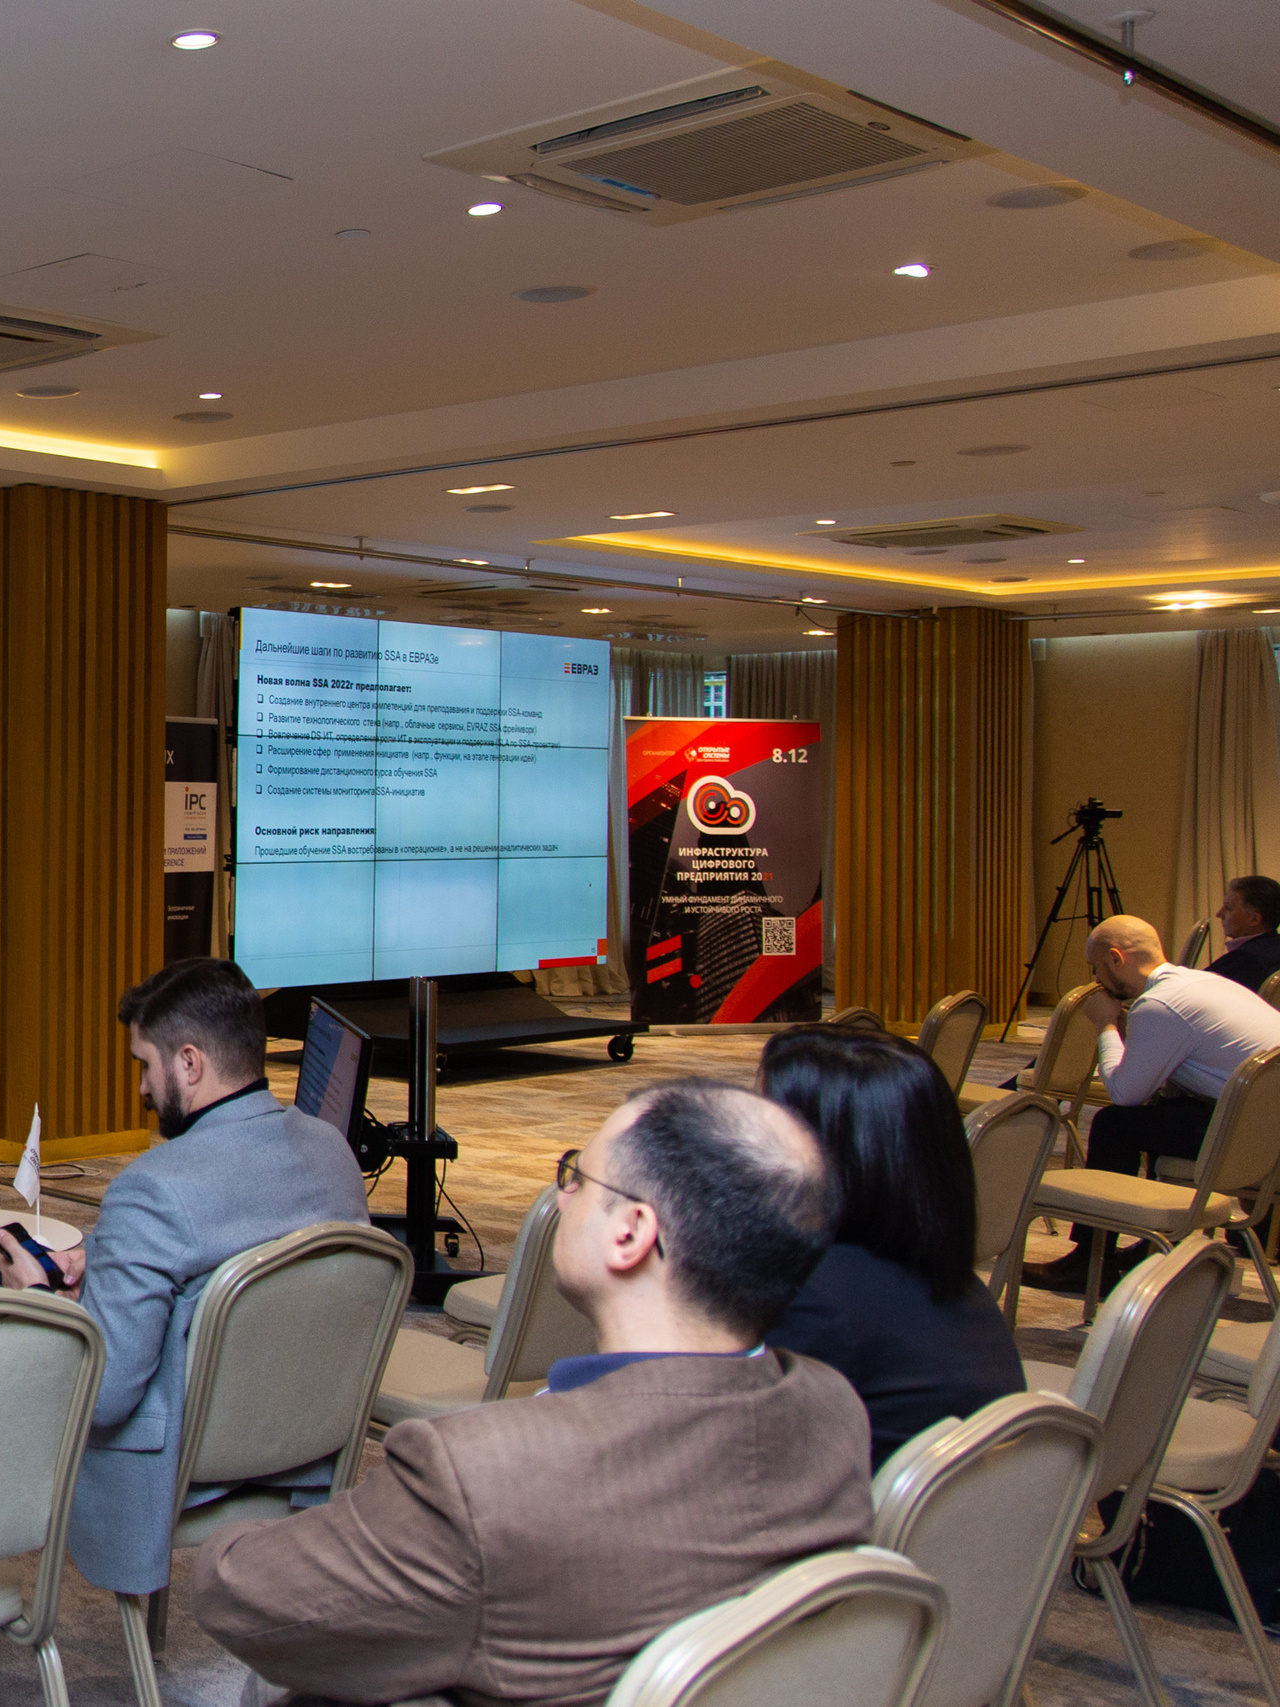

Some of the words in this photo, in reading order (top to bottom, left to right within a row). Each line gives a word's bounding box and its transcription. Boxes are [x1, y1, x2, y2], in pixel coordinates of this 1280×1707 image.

[255, 640, 310, 655] Дальнейшие
[311, 646, 331, 657] шаги
[333, 648, 343, 658] по
[345, 649, 383, 661] развитию
[384, 650, 401, 662] SSA
[402, 654, 407, 662] в
[409, 651, 439, 664] ЕВРАЗе
[571, 663, 599, 676] ЕВРАЗ
[257, 674, 283, 686] Новая
[285, 678, 311, 688] волна
[312, 678, 329, 689] SSA
[331, 679, 354, 690] 2022г
[355, 682, 412, 693] предполагает:
[268, 694, 304, 706] Создание
[305, 698, 346, 709] внутреннего
[347, 701, 371, 711] центра
[414, 704, 426, 715] для
[268, 712, 301, 724] Развитие
[302, 715, 361, 727] технологического
[467, 722, 488, 733] EVRAZ
[268, 745, 312, 757] Расширение
[313, 746, 331, 758] сфер
[772, 748, 808, 763] 8.12
[267, 764, 320, 777] Формирование
[320, 766, 373, 777] дистанционного
[393, 767, 423, 779] обучения
[423, 768, 438, 778] SSA
[267, 784, 302, 796] Создание
[302, 786, 332, 796] системы
[255, 826, 297, 836] Основной
[299, 827, 320, 837] риск
[168, 845, 207, 856] ПРИЛОЖЕНИЙ
[255, 846, 298, 858] Прошедшие
[299, 845, 331, 857] обучение
[331, 845, 347, 855] SSA
[678, 847, 769, 857] ИНФРАСТРУКТУРА
[691, 859, 756, 871] ЦИФРОВОГО
[676, 872, 749, 883] ПРЕДПРИЯТИЯ
[751, 872, 773, 881] 2021
[661, 894, 687, 904] УМНЫЙ
[740, 906, 763, 914] РОСТА
